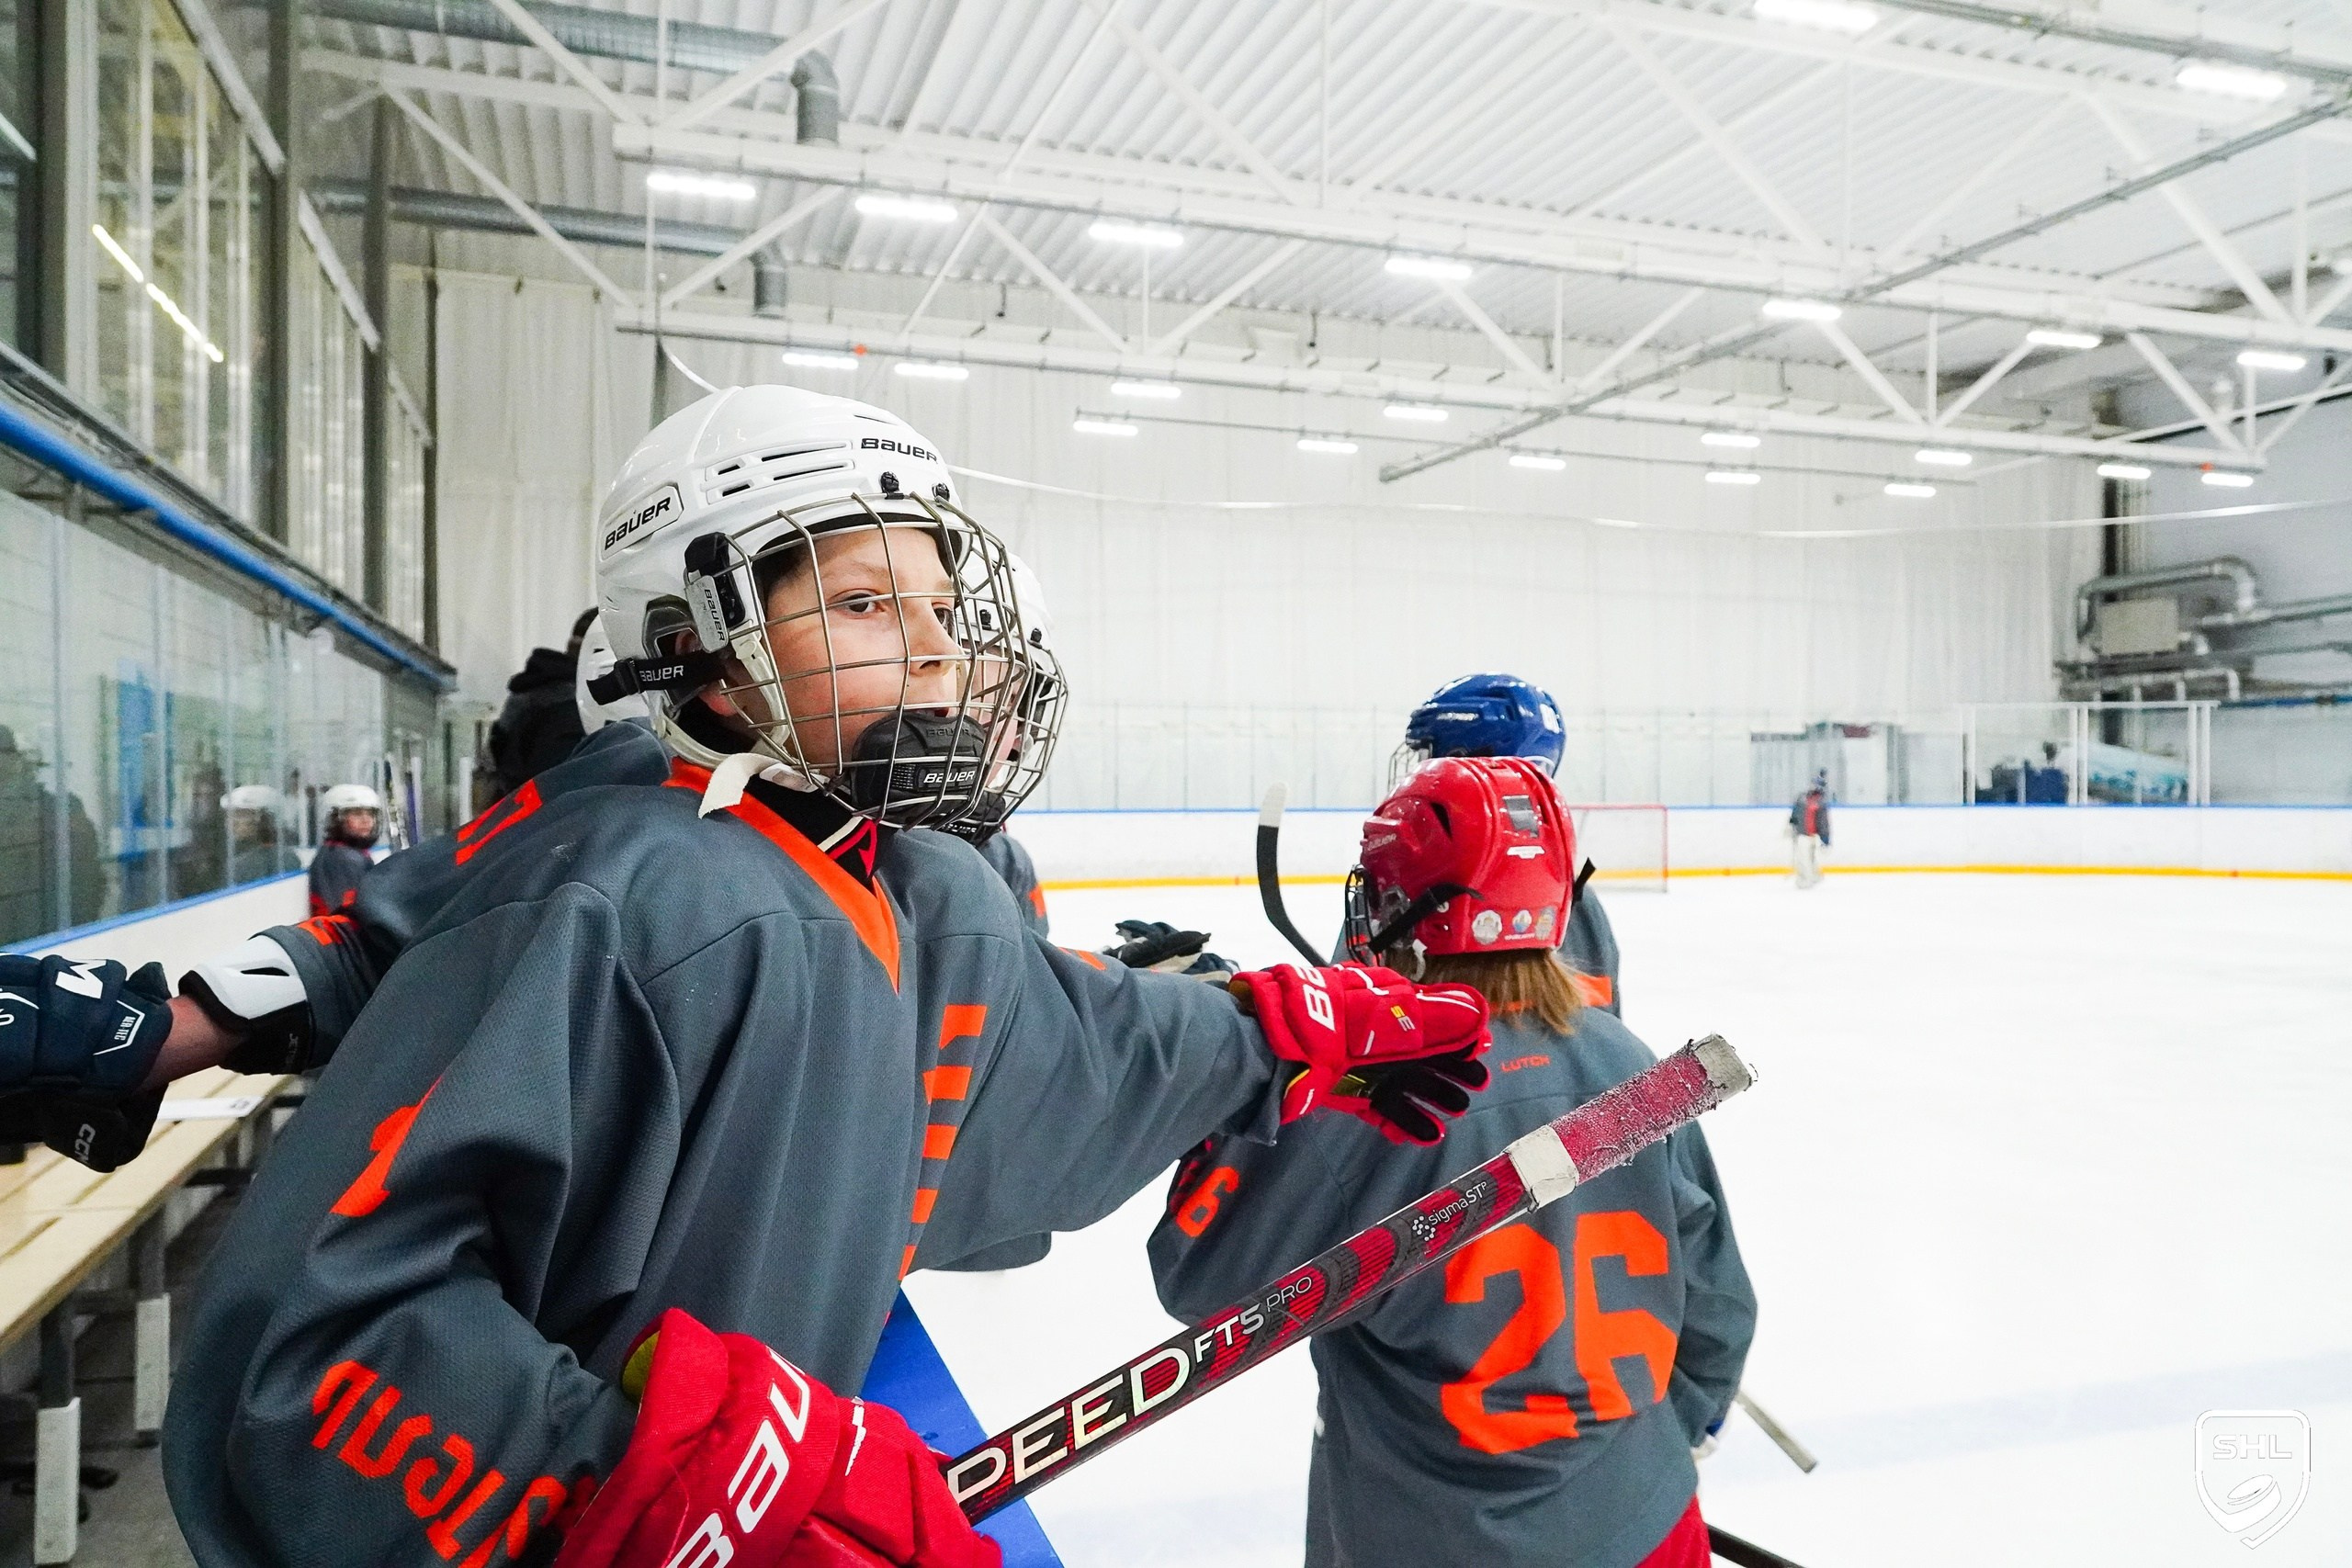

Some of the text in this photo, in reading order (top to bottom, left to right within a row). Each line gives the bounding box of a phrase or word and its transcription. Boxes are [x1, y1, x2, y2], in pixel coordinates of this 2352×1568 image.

[604, 496, 671, 551] BAUER
[861, 437, 938, 464] BAUER
[704, 589, 726, 641] BAUER
[946, 1346, 1192, 1506] PEED
[1265, 1275, 1313, 1314] PRO
[1441, 1210, 1679, 1455] 26
[311, 1359, 571, 1568] утель
[662, 1344, 811, 1568] BAU
